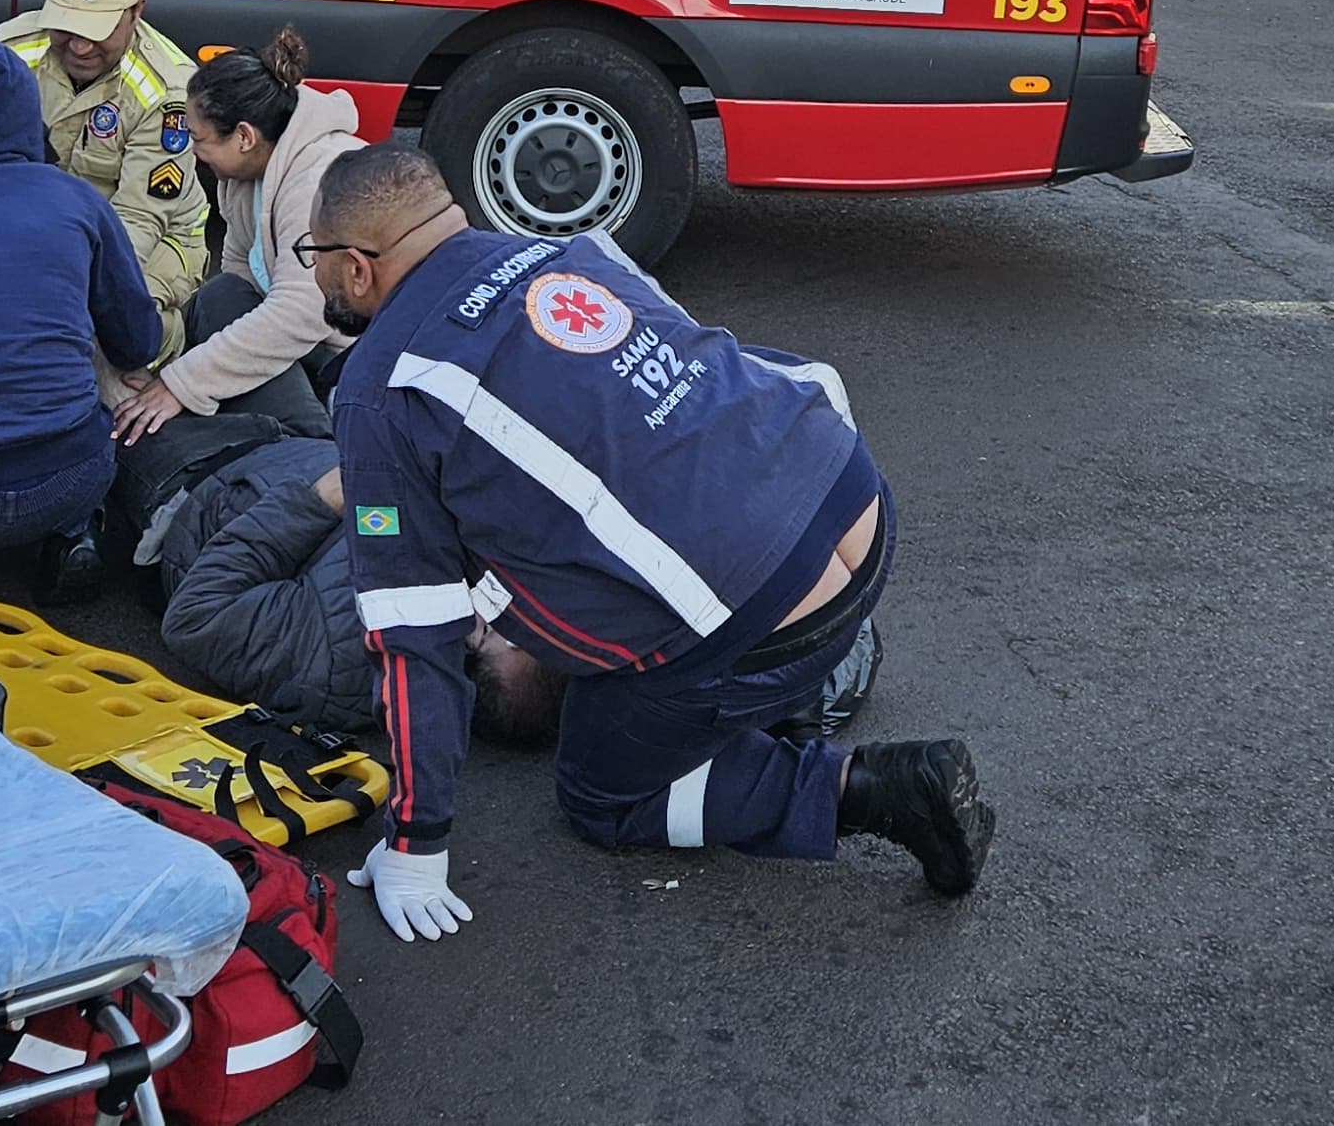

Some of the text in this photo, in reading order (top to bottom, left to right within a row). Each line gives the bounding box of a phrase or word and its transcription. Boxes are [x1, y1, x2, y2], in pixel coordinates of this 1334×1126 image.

[458, 281, 501, 319] COND.
[612, 327, 660, 377] SAMU
[631, 343, 685, 400] 192
[643, 379, 692, 430] Apucarana
[687, 359, 708, 379] PR
